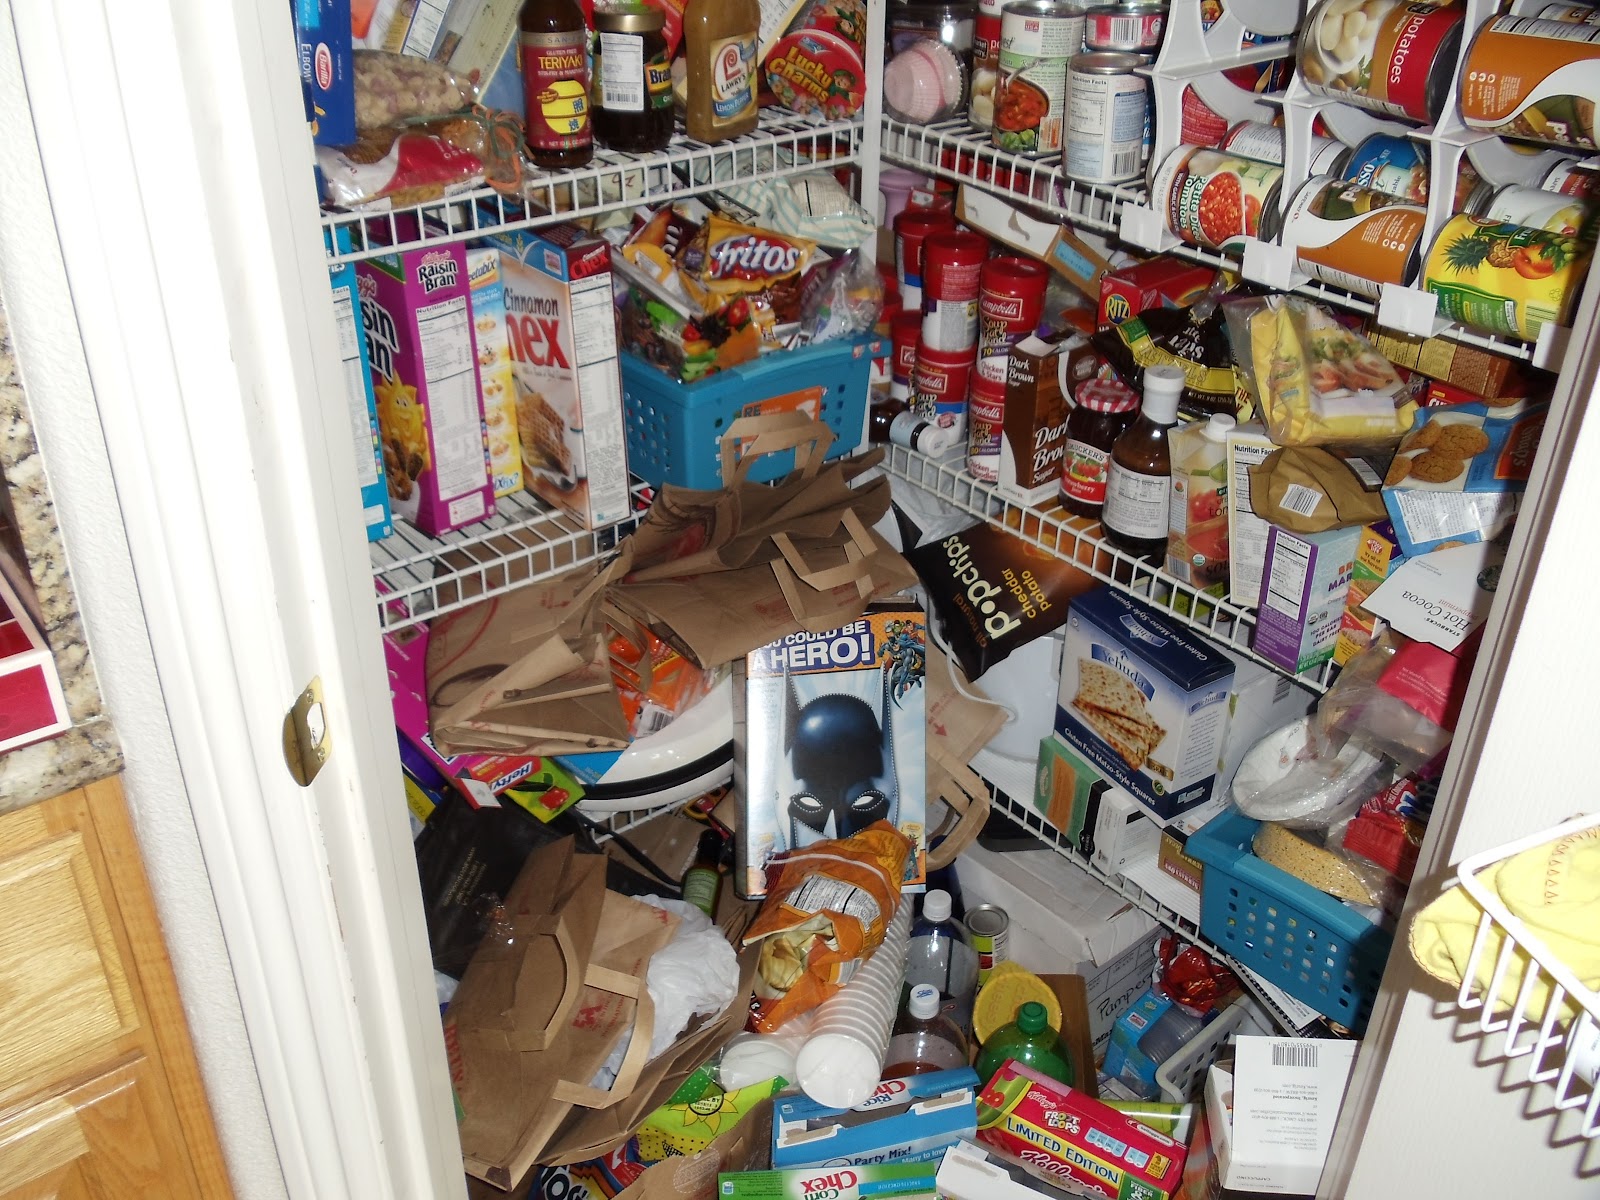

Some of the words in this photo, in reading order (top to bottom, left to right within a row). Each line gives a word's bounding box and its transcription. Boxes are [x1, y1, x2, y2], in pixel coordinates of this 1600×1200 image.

[1391, 17, 1425, 85] potatoes
[318, 53, 330, 85] Barilla
[538, 56, 583, 70] TERIYAKI
[786, 46, 833, 89] Lucky
[720, 73, 748, 93] LAWRY'S
[769, 57, 830, 102] Charms
[715, 101, 735, 113] LEMON
[1175, 172, 1184, 187] WITH
[1180, 175, 1197, 229] Tomatoes
[1190, 175, 1208, 212] Petite
[1190, 214, 1204, 242] Diced
[418, 260, 457, 282] Raisin
[468, 258, 496, 281] eetabix
[425, 274, 455, 292] Bran
[416, 303, 447, 314] Nutrition
[448, 297, 465, 306] Facts
[503, 286, 559, 317] Cinnamon
[981, 298, 1018, 316] ampbell's
[1105, 298, 1130, 320] RITZ
[981, 360, 1005, 374] Chicken
[1009, 355, 1030, 370] Dark
[1008, 368, 1035, 384] Brown
[1237, 386, 1251, 404] THE
[1032, 444, 1065, 472] Bro
[1234, 444, 1260, 455] Nutrition
[1032, 466, 1056, 484] Sugar
[1278, 532, 1296, 545] Nutrition
[1296, 540, 1310, 550] Facts
[942, 535, 1022, 640] popchips
[1001, 568, 1037, 619] cheddar
[1021, 570, 1052, 612] potato
[1108, 590, 1135, 611] Squares
[1402, 590, 1442, 617] Cocoa
[843, 620, 866, 634] BE
[1425, 617, 1461, 637] STARBUCKS
[1443, 611, 1473, 632] Hot
[1169, 633, 1186, 648] Free
[1312, 637, 1327, 647] DAIRY
[753, 655, 767, 673] A
[771, 634, 871, 669] HERO!
[1185, 643, 1208, 661] Gluten
[1101, 646, 1147, 690] Yehuda
[1064, 727, 1083, 748] Gluten
[1082, 741, 1097, 758] Free
[1095, 753, 1132, 786] Matzo-Style
[1131, 781, 1156, 806] Squares
[862, 1093, 892, 1107] Rice
[1027, 1090, 1057, 1109] Kellogg's
[1044, 1110, 1080, 1126] FROOT
[1047, 1117, 1080, 1135] LOOPS
[854, 1154, 885, 1167] Party
[888, 1146, 912, 1161] Mix!
[902, 1154, 922, 1164] Many
[931, 1148, 947, 1159] love
[1006, 1117, 1061, 1153] LIMITED
[1065, 1146, 1120, 1184] EDITION
[801, 1170, 858, 1195] Chex
